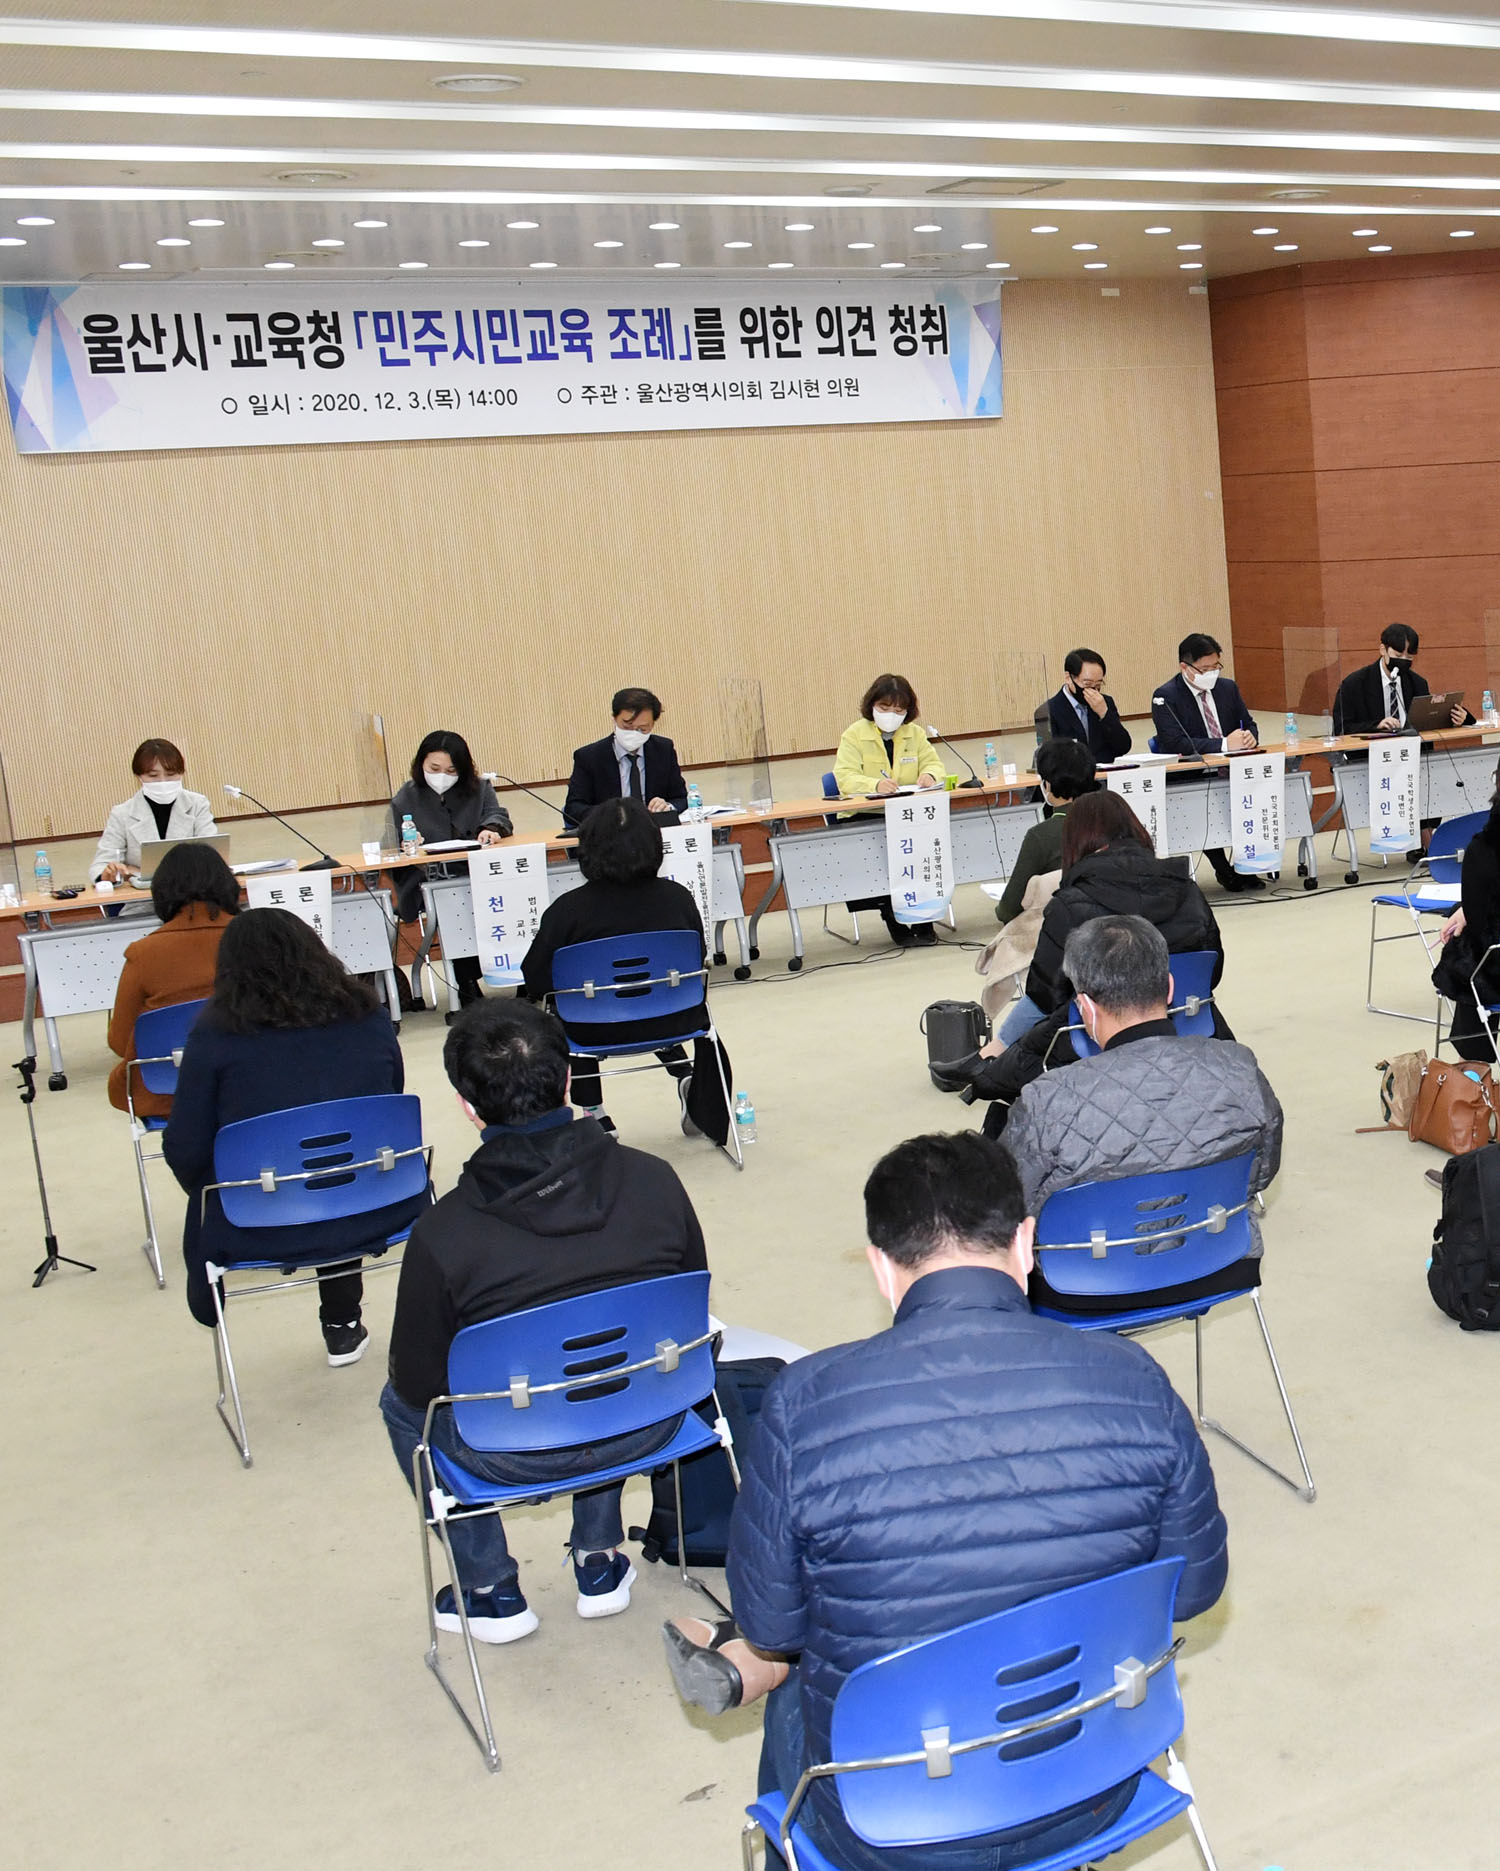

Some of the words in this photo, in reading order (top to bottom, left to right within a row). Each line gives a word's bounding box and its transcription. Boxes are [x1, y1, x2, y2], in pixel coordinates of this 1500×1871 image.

[81, 310, 346, 375] 울산시·교육청
[606, 306, 727, 362] 조례」를
[737, 304, 804, 360] 위한
[815, 304, 879, 358] 의견
[887, 303, 950, 357] 청취
[247, 392, 291, 417] 일시
[311, 392, 368, 413] 2020.
[374, 391, 402, 412] 12.
[407, 387, 461, 411] 3.(목)
[467, 388, 518, 407] 14:00
[580, 383, 619, 406] 주관
[636, 380, 763, 404] 울산광역시의회
[769, 378, 821, 400] 김시현
[826, 377, 861, 398] 의원
[901, 805, 937, 822] 좌장
[1241, 794, 1256, 860] 신영철
[1380, 776, 1393, 839] 최인호
[899, 837, 918, 908] 김시현
[922, 856, 931, 883] 시의원
[933, 837, 945, 898] 울산광역시의회
[487, 895, 513, 972] 천주미
[516, 919, 526, 938] 교사
